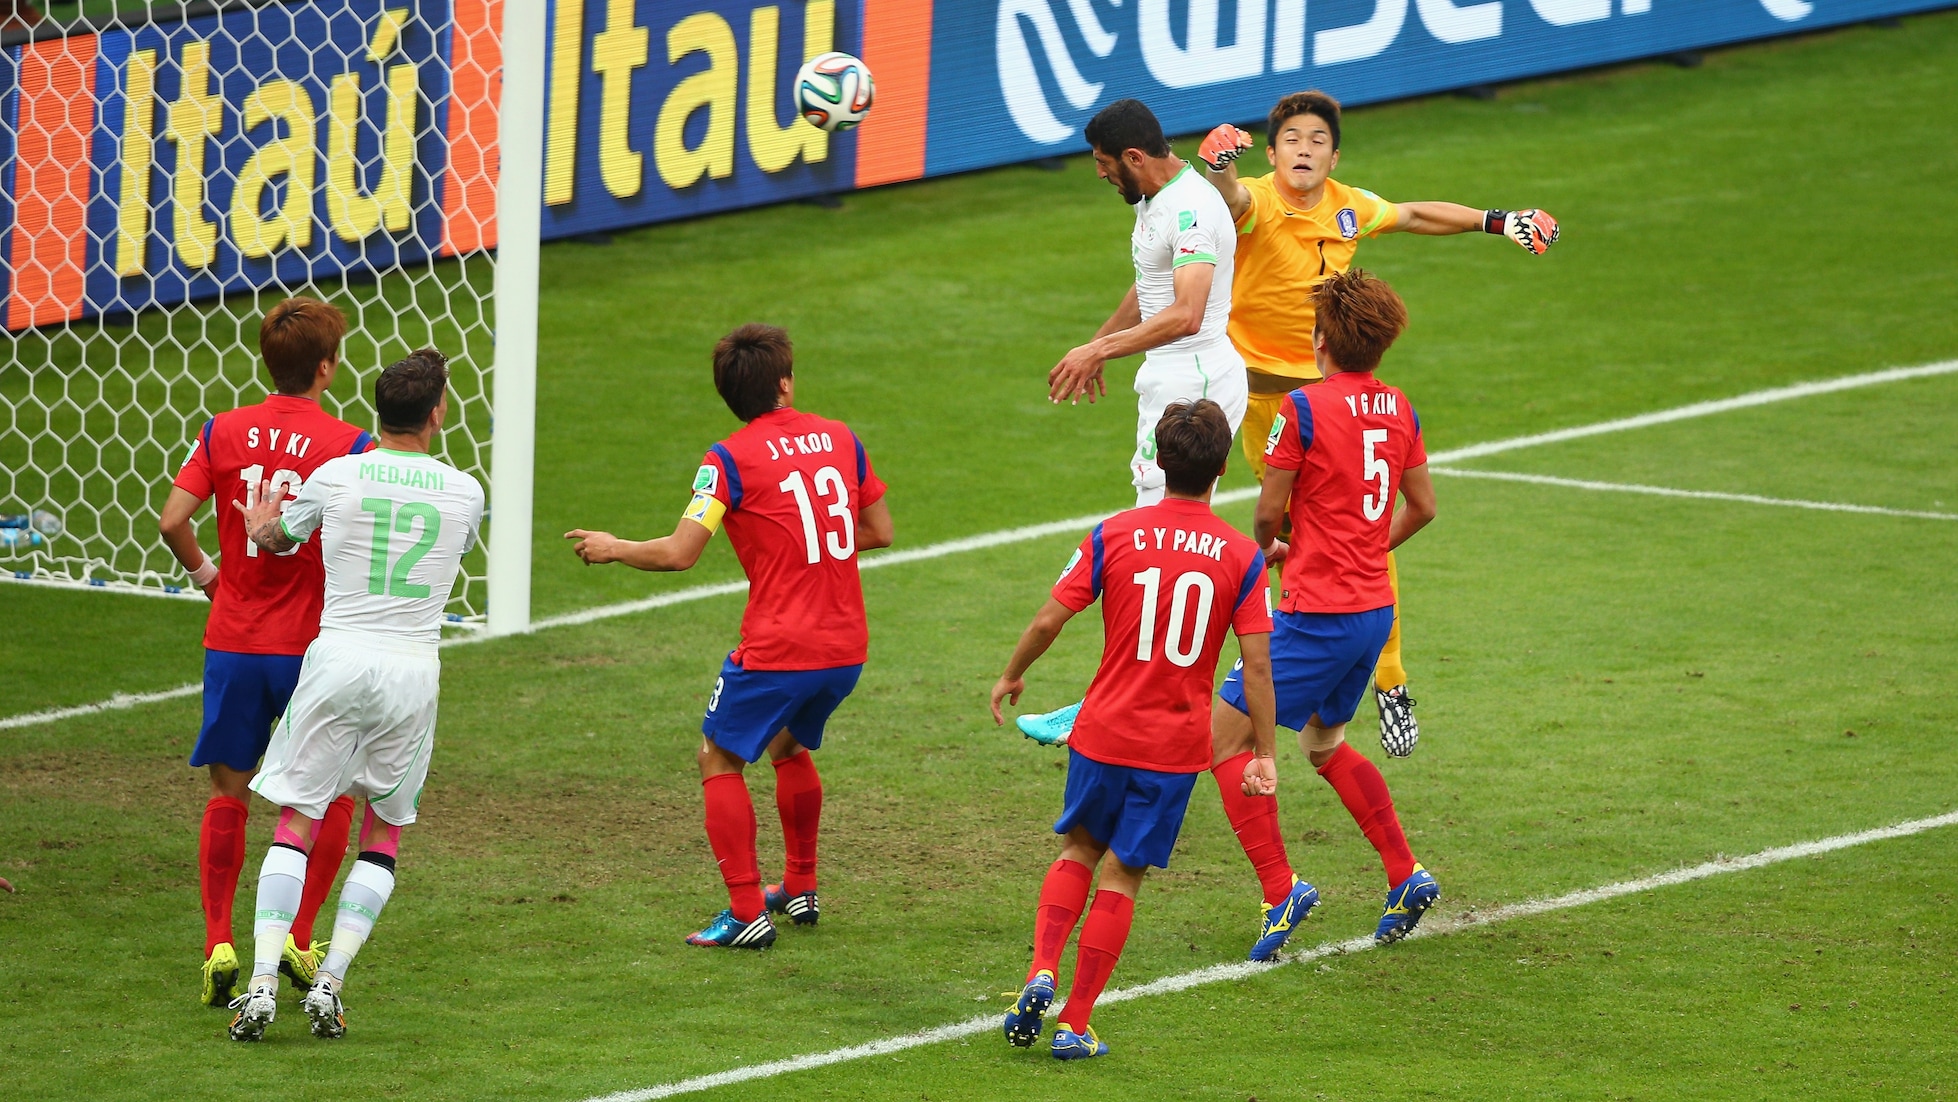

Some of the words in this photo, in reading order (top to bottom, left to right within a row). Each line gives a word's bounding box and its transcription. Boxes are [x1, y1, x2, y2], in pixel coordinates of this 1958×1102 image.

[115, 8, 418, 277] Itaú
[1317, 239, 1326, 276] 1
[1345, 394, 1357, 417] Y
[1360, 393, 1369, 415] G
[1372, 392, 1398, 416] KIM
[247, 427, 260, 449] S
[269, 428, 281, 451] Y
[285, 433, 312, 458] KI
[766, 439, 780, 461] J
[780, 437, 794, 457] C
[796, 432, 833, 455] KOO
[359, 462, 444, 491] MEDJANI
[1362, 428, 1390, 522] 5
[778, 466, 855, 565] 13
[361, 497, 441, 599] 12
[1133, 529, 1147, 551] C
[1153, 527, 1167, 550] Y
[1172, 529, 1228, 562] PARK
[1133, 566, 1215, 668] 10
